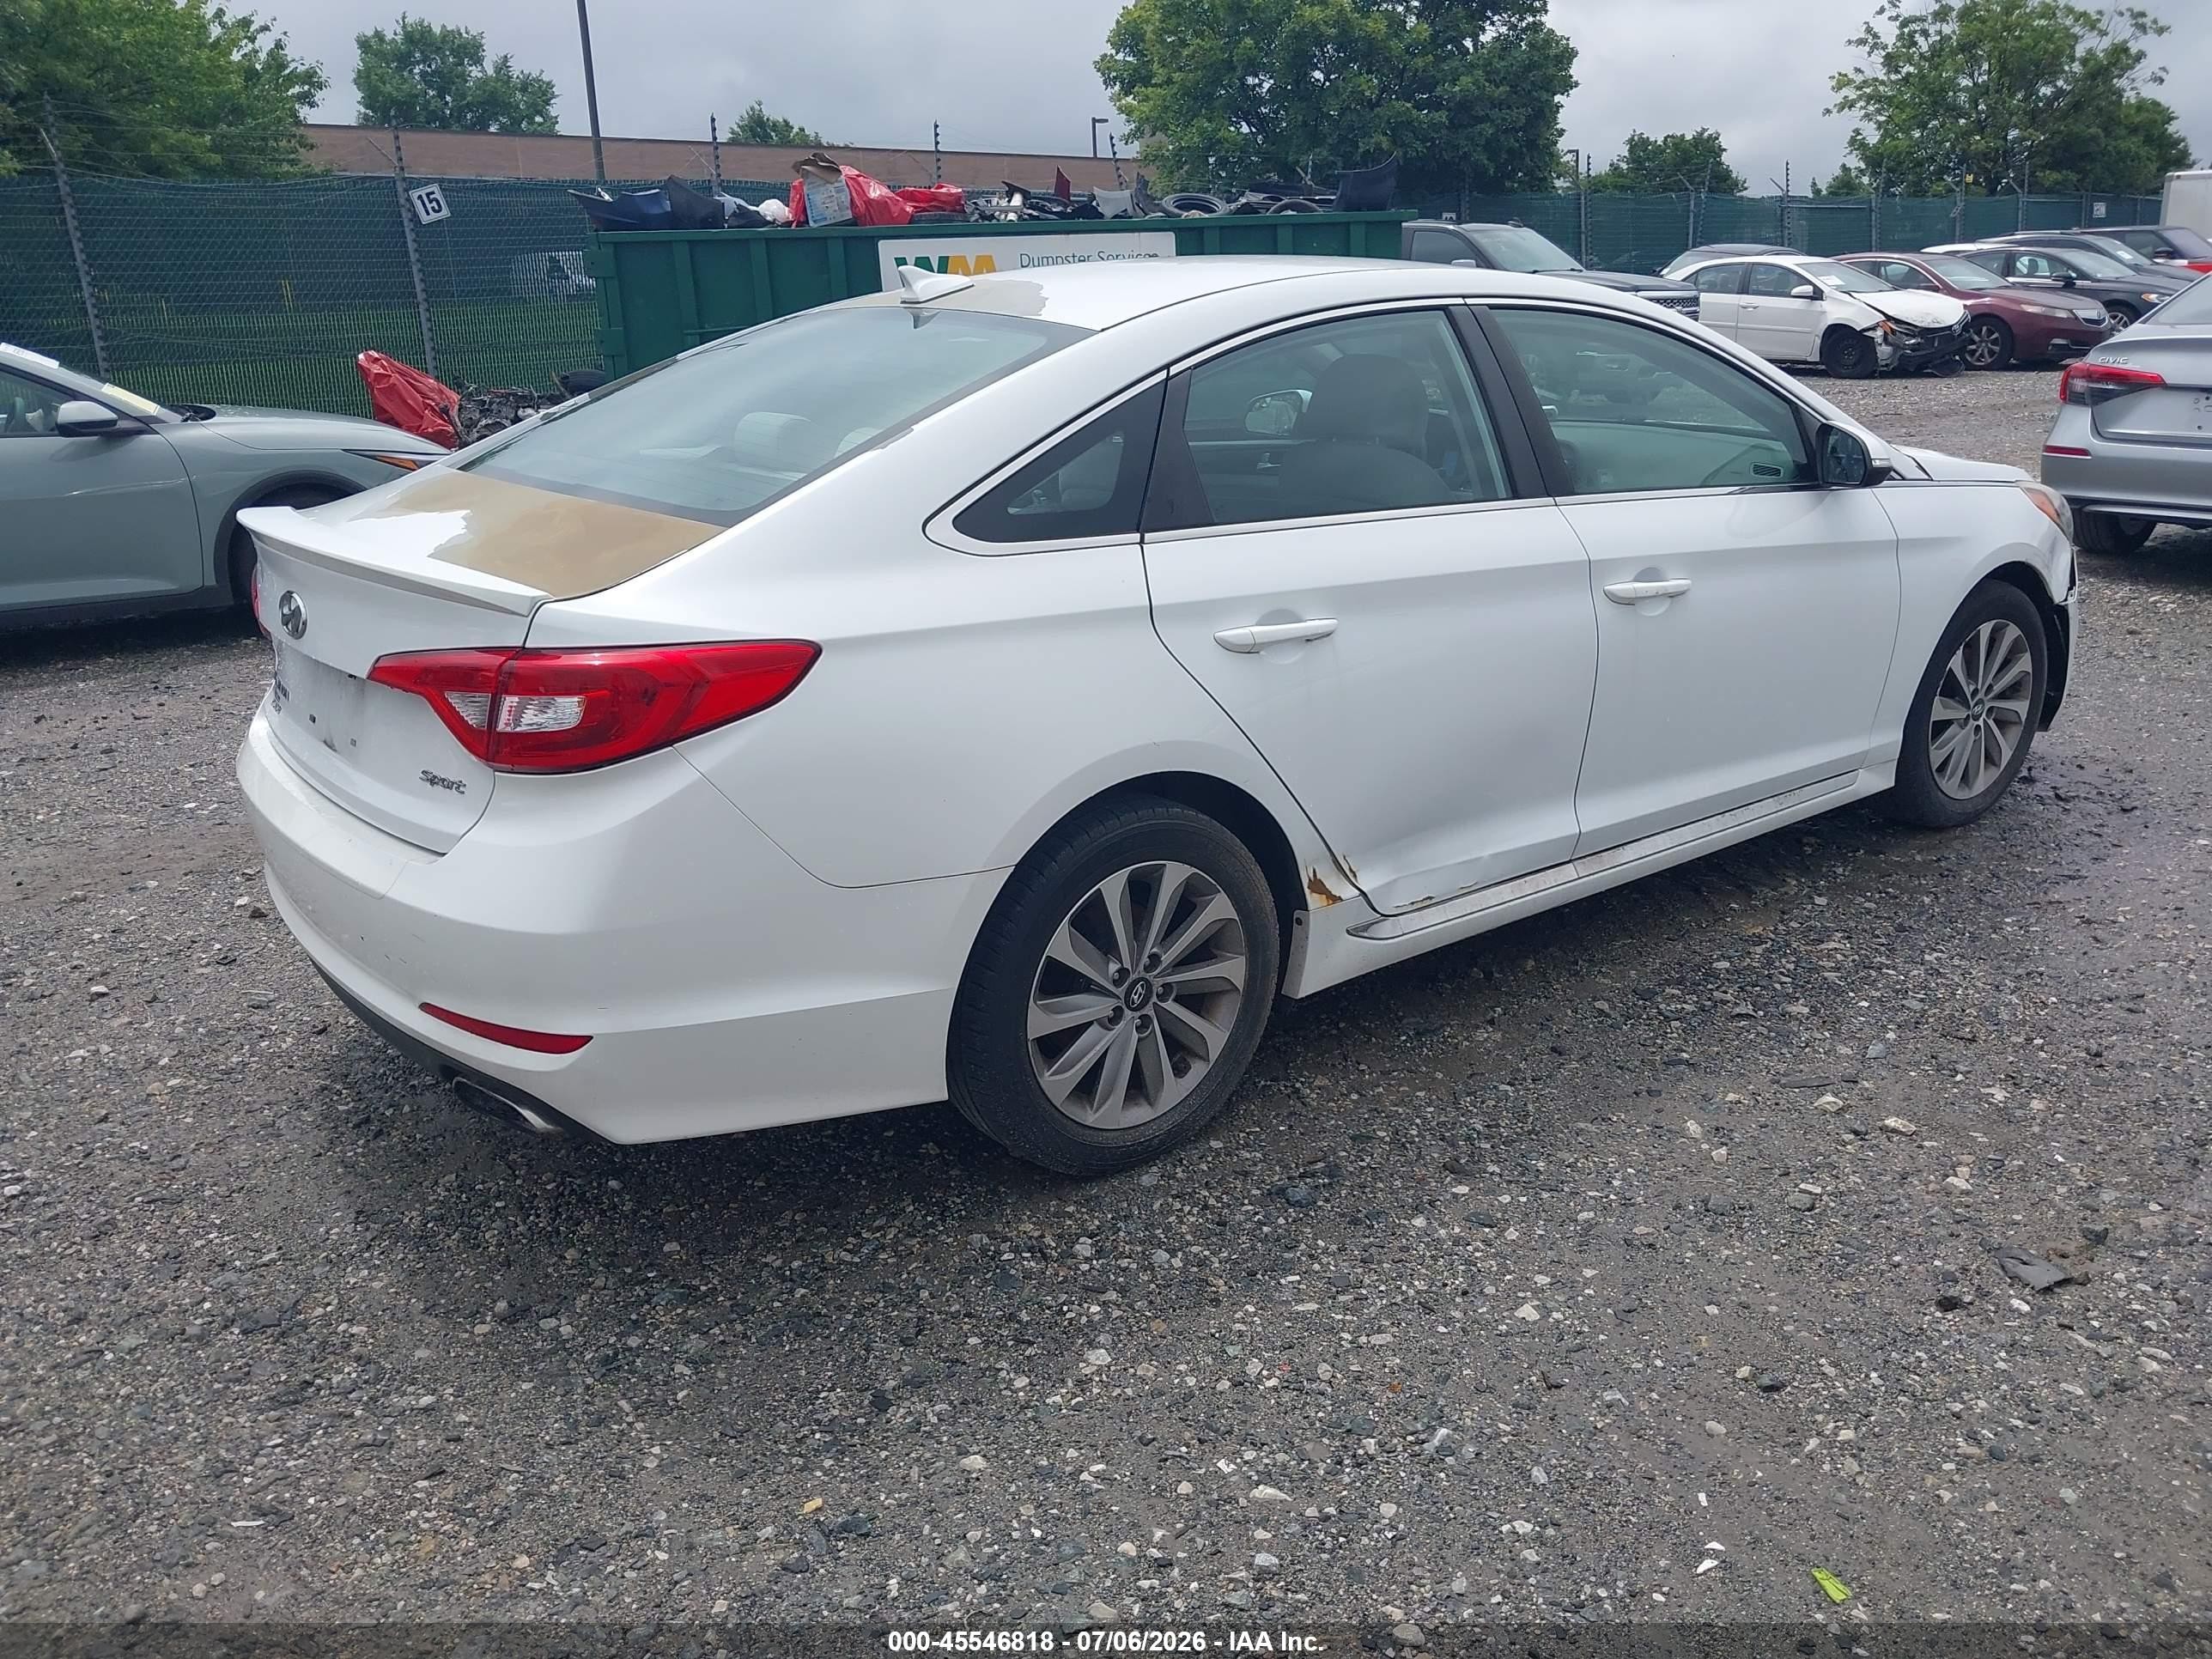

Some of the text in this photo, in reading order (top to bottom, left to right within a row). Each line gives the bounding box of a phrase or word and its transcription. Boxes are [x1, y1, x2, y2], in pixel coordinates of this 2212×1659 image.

[417, 191, 443, 216] 15
[2099, 356, 2129, 365] CIVIC
[418, 769, 466, 795] Sport
